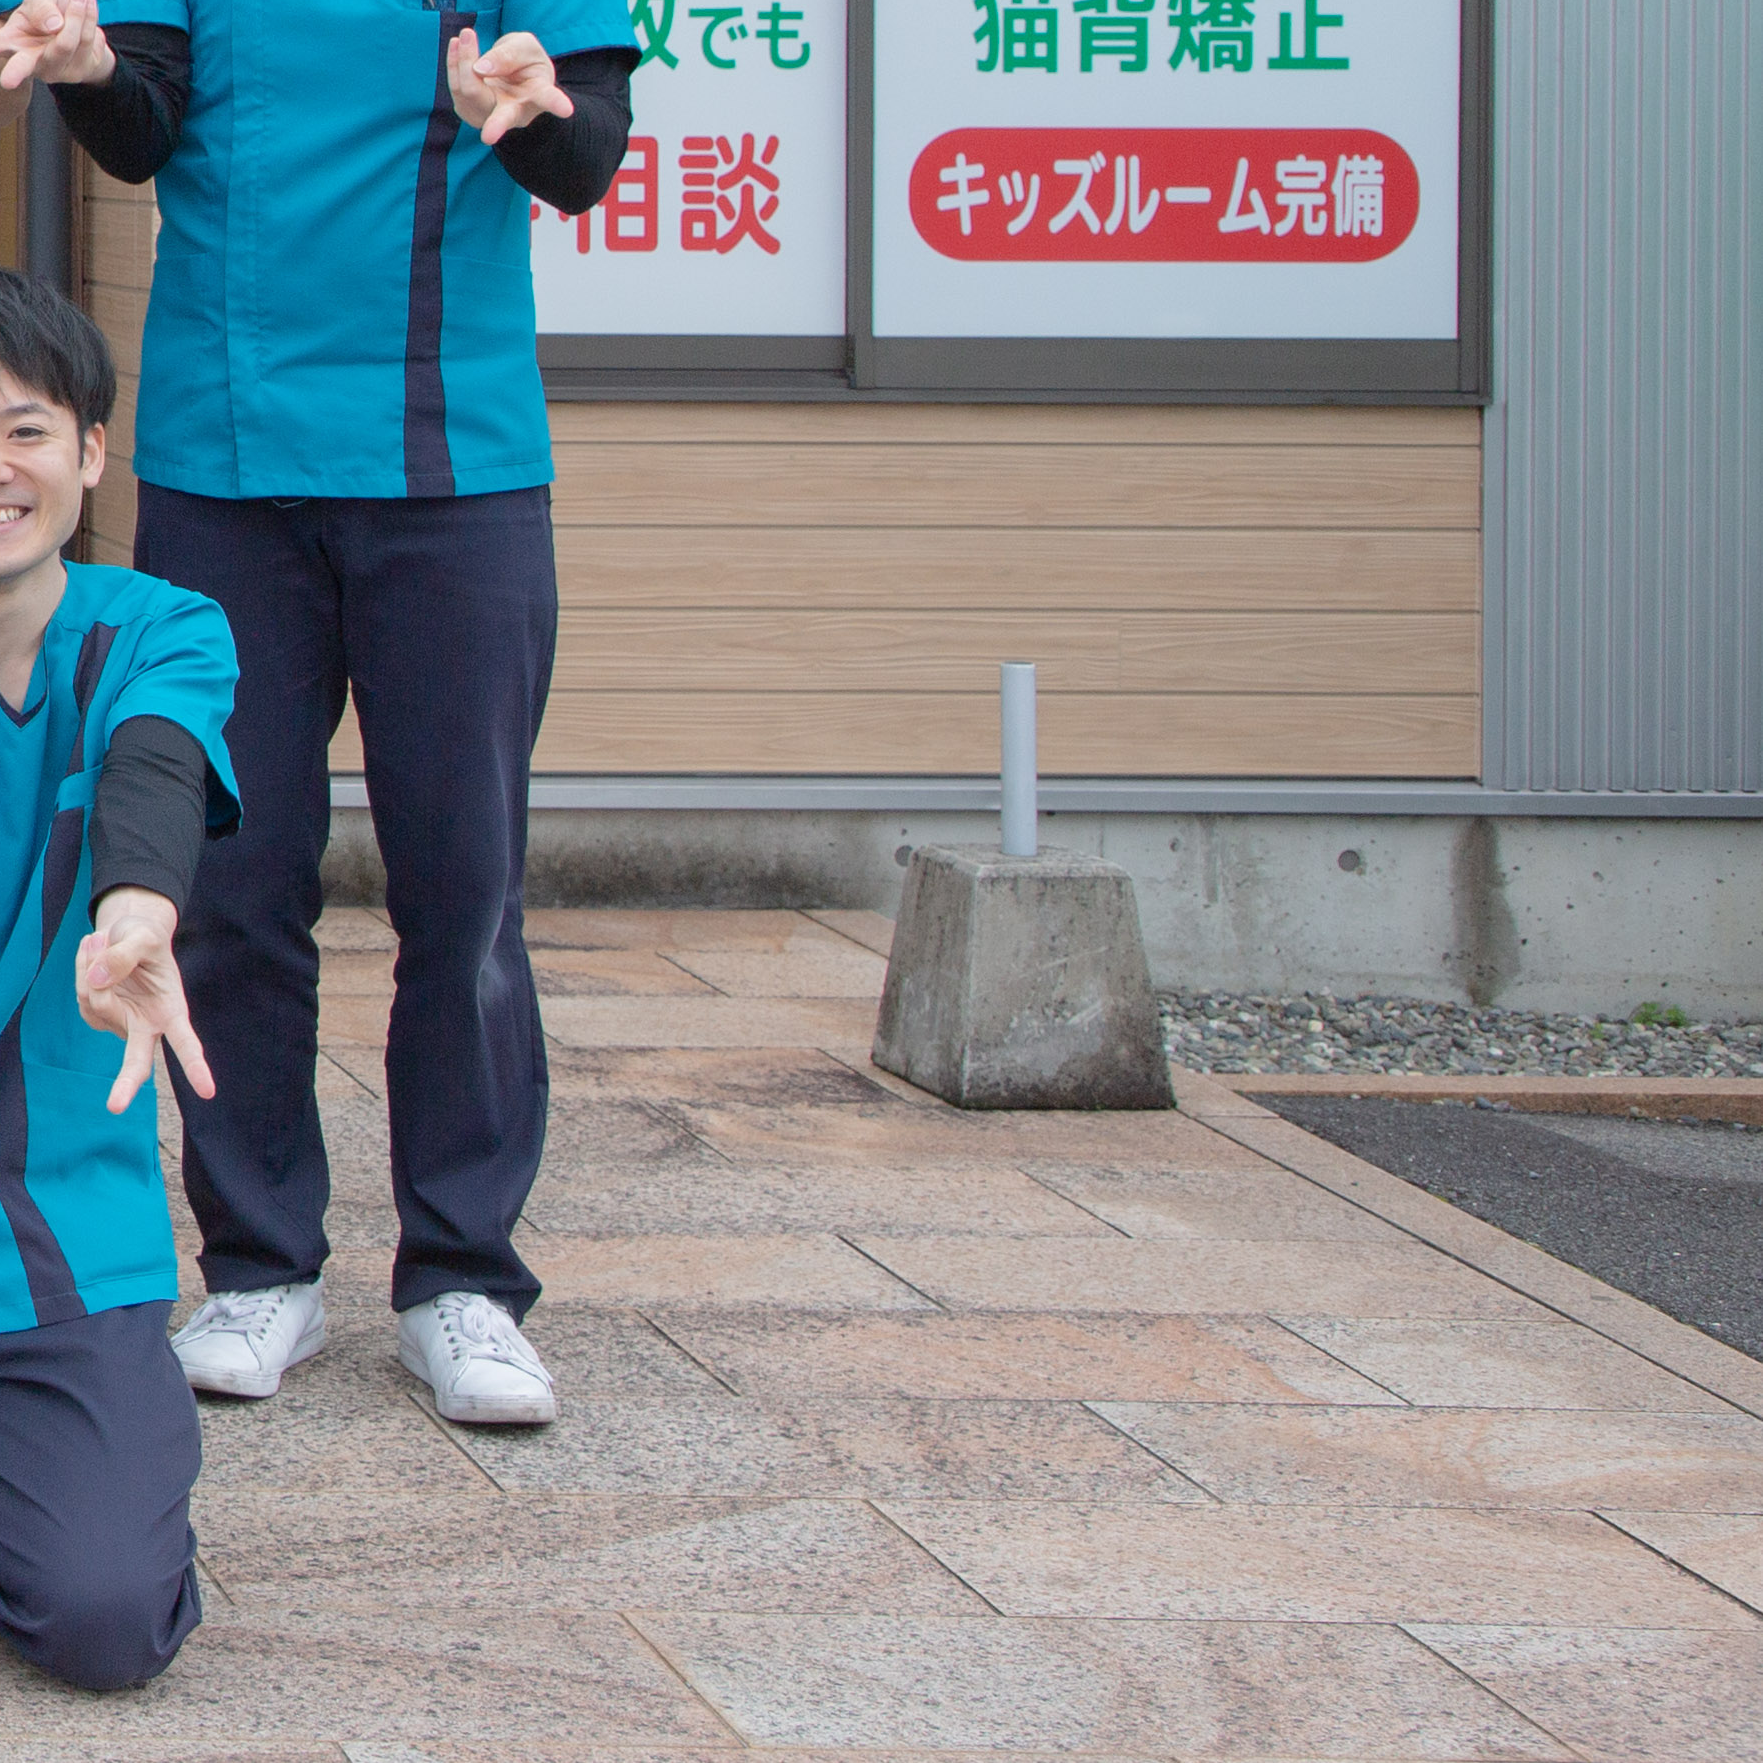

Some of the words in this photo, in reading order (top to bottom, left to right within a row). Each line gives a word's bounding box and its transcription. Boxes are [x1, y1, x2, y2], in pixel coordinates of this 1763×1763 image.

[531, 133, 781, 255] 相談
[936, 151, 1384, 240] キッズルーム完備
